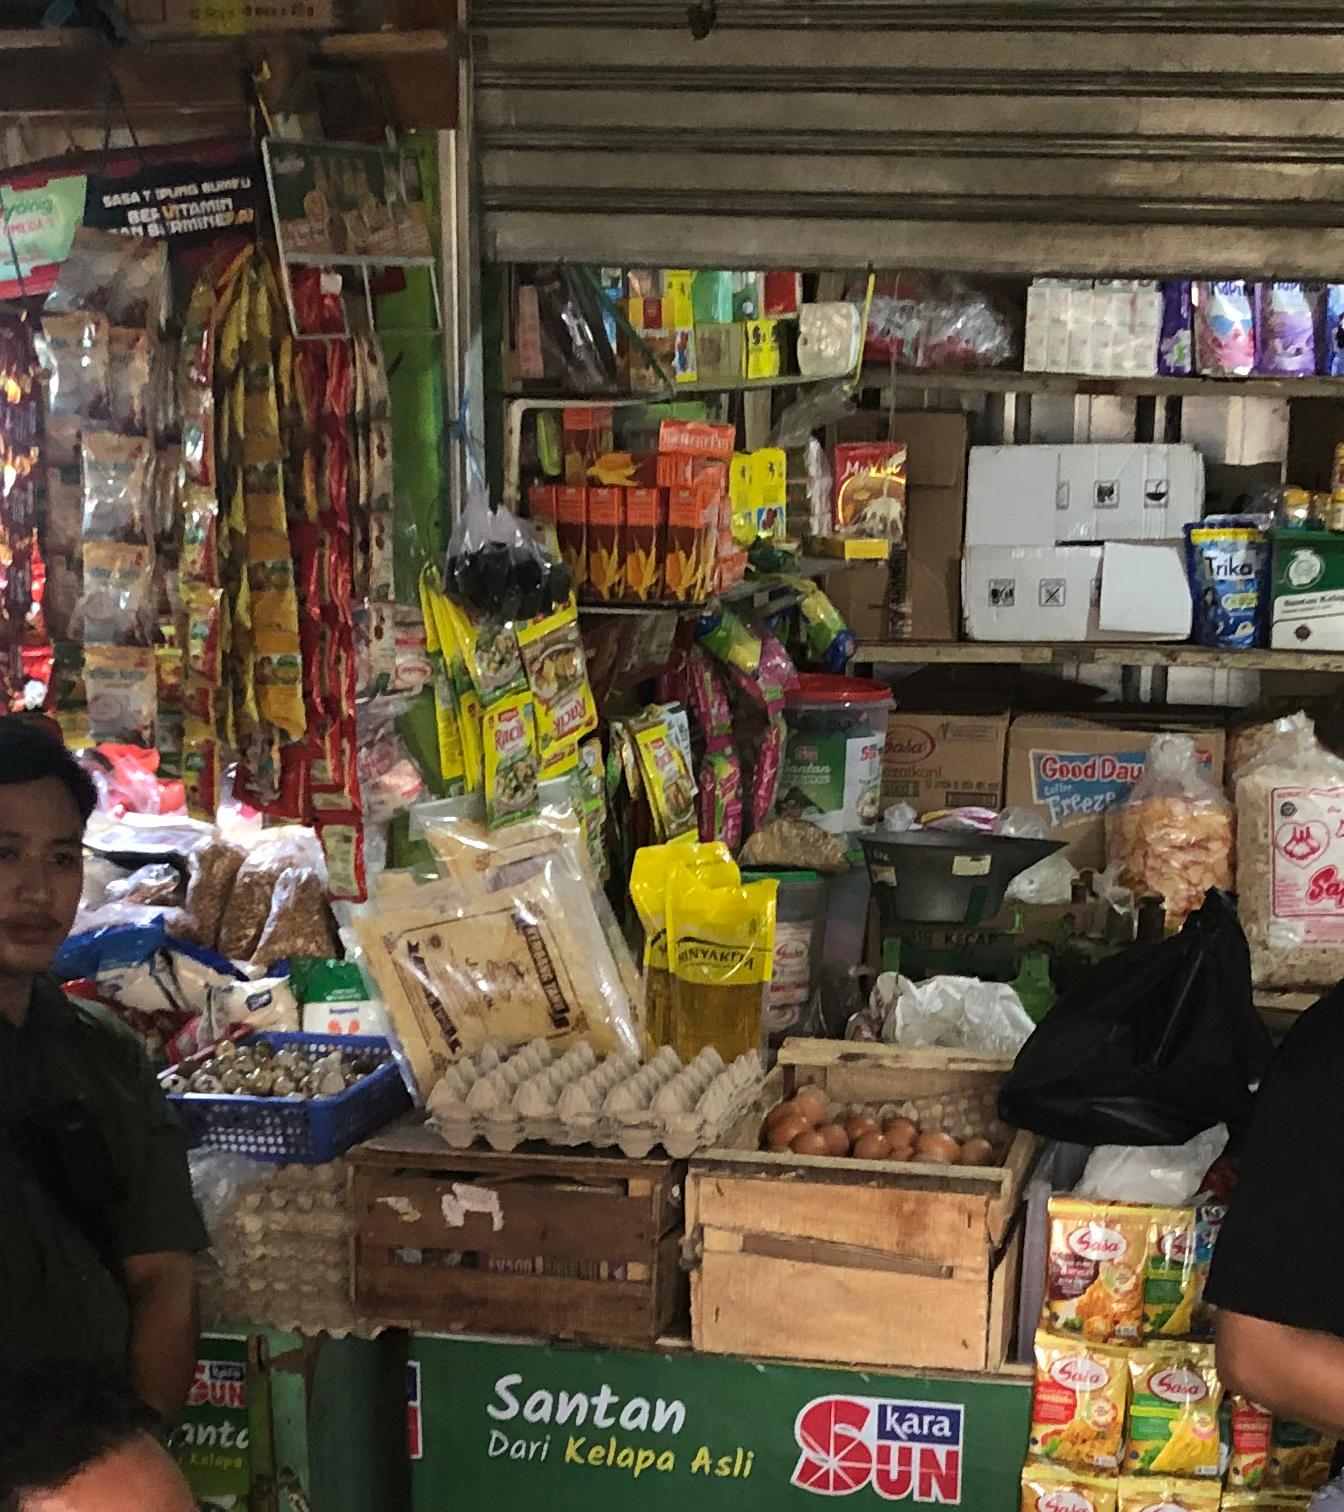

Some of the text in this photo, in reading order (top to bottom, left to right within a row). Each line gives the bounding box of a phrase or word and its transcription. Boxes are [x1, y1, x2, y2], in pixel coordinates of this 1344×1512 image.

[1205, 555, 1255, 577] Trika
[1040, 755, 1098, 781] Good
[1045, 790, 1117, 828] Freeze
[1076, 1229, 1121, 1253] Sasa
[1058, 1361, 1101, 1385] Sasa
[1158, 1372, 1199, 1394] Sasa
[486, 1373, 953, 1441] Santan kara
[487, 1428, 755, 1479] Dari Kelapa Asli
[791, 1395, 964, 1504] SUN
